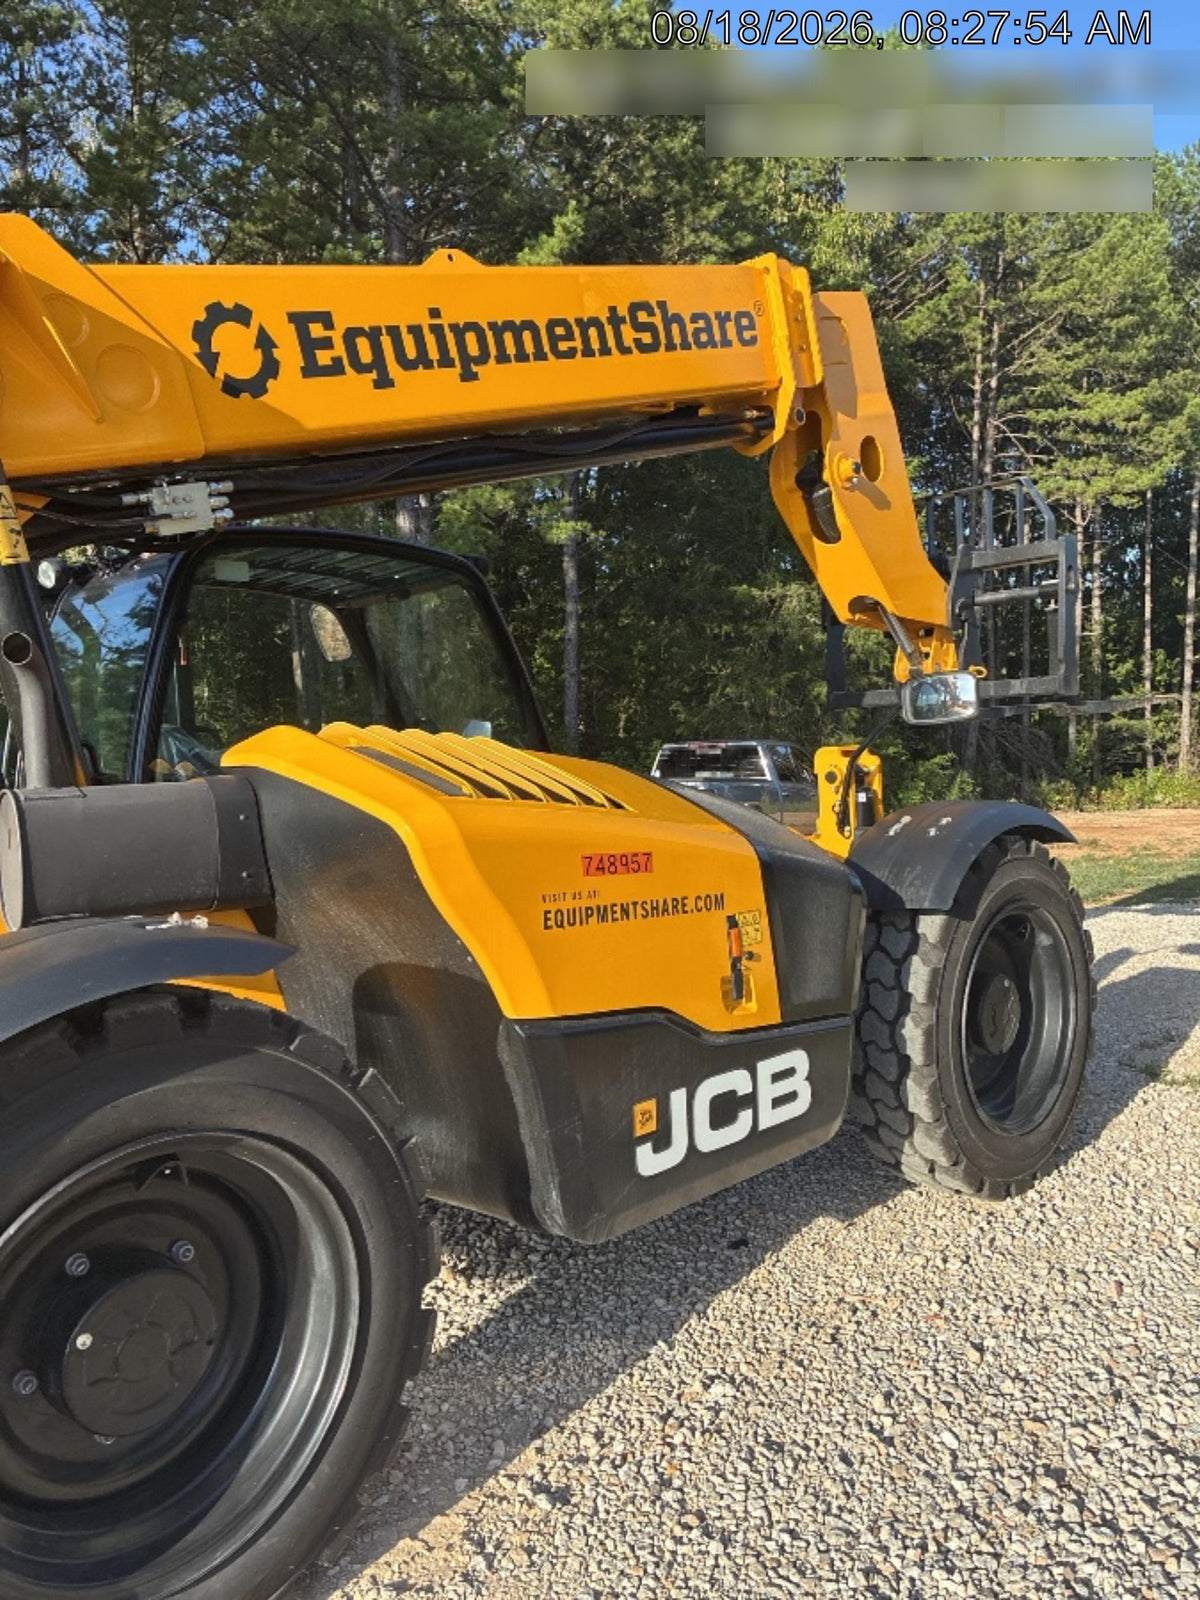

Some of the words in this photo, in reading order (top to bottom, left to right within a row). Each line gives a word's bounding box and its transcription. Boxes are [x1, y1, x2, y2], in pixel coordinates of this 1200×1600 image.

[583, 852, 652, 876] 748957
[541, 891, 567, 904] VISIT
[571, 889, 583, 901] US
[543, 892, 725, 931] EQUIPMENTSHARE.COM
[635, 1049, 812, 1177] JCB
